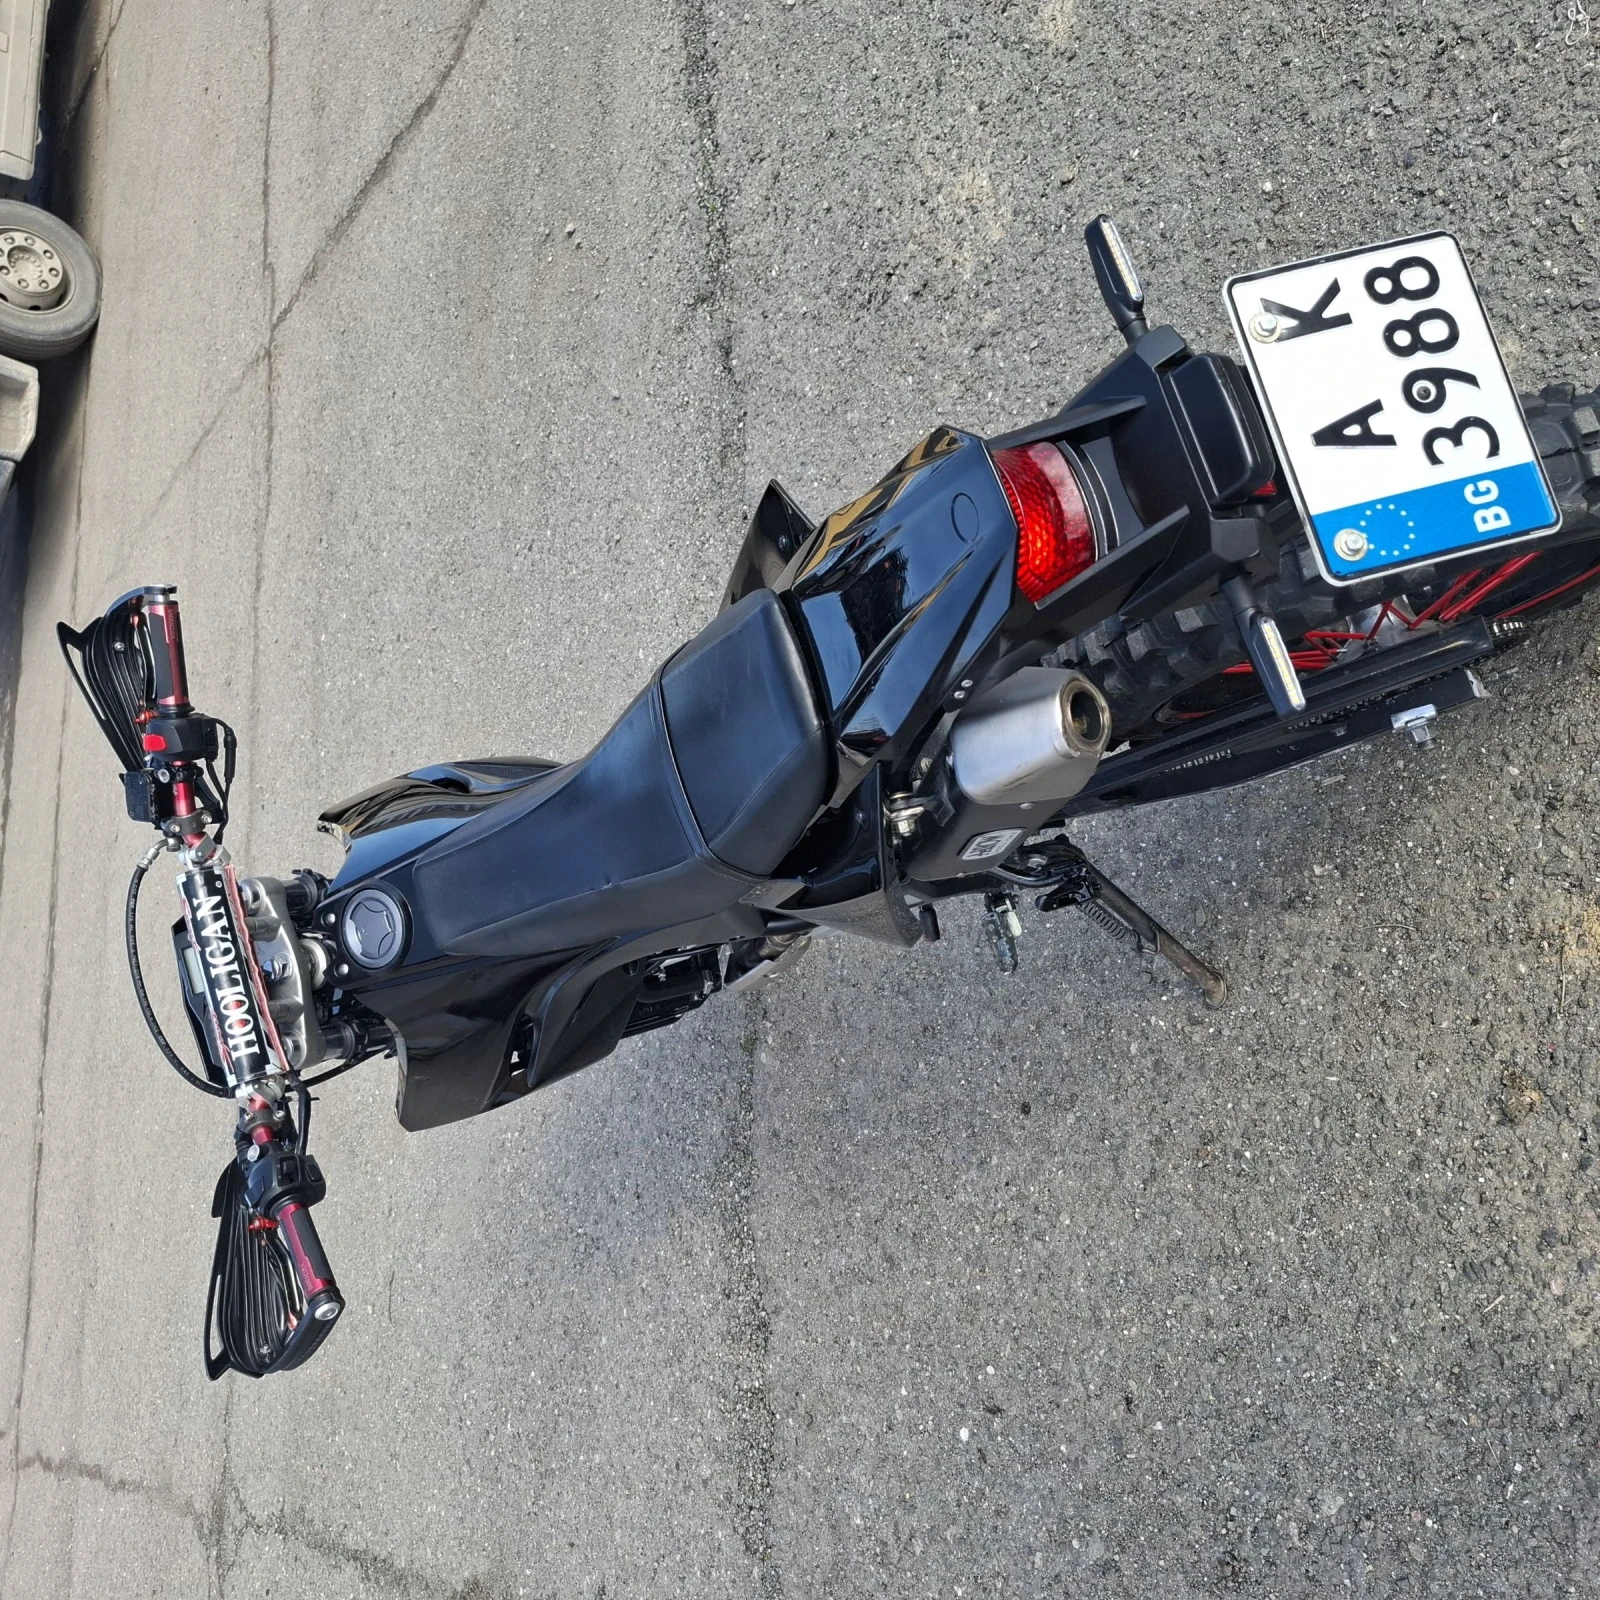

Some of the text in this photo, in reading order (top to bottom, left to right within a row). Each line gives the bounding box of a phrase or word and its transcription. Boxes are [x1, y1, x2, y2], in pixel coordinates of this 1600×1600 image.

[1260, 277, 1397, 448] A K
[1363, 255, 1500, 466] 3988
[1463, 479, 1511, 533] BG
[193, 896, 261, 1062] HOOLIGAN
